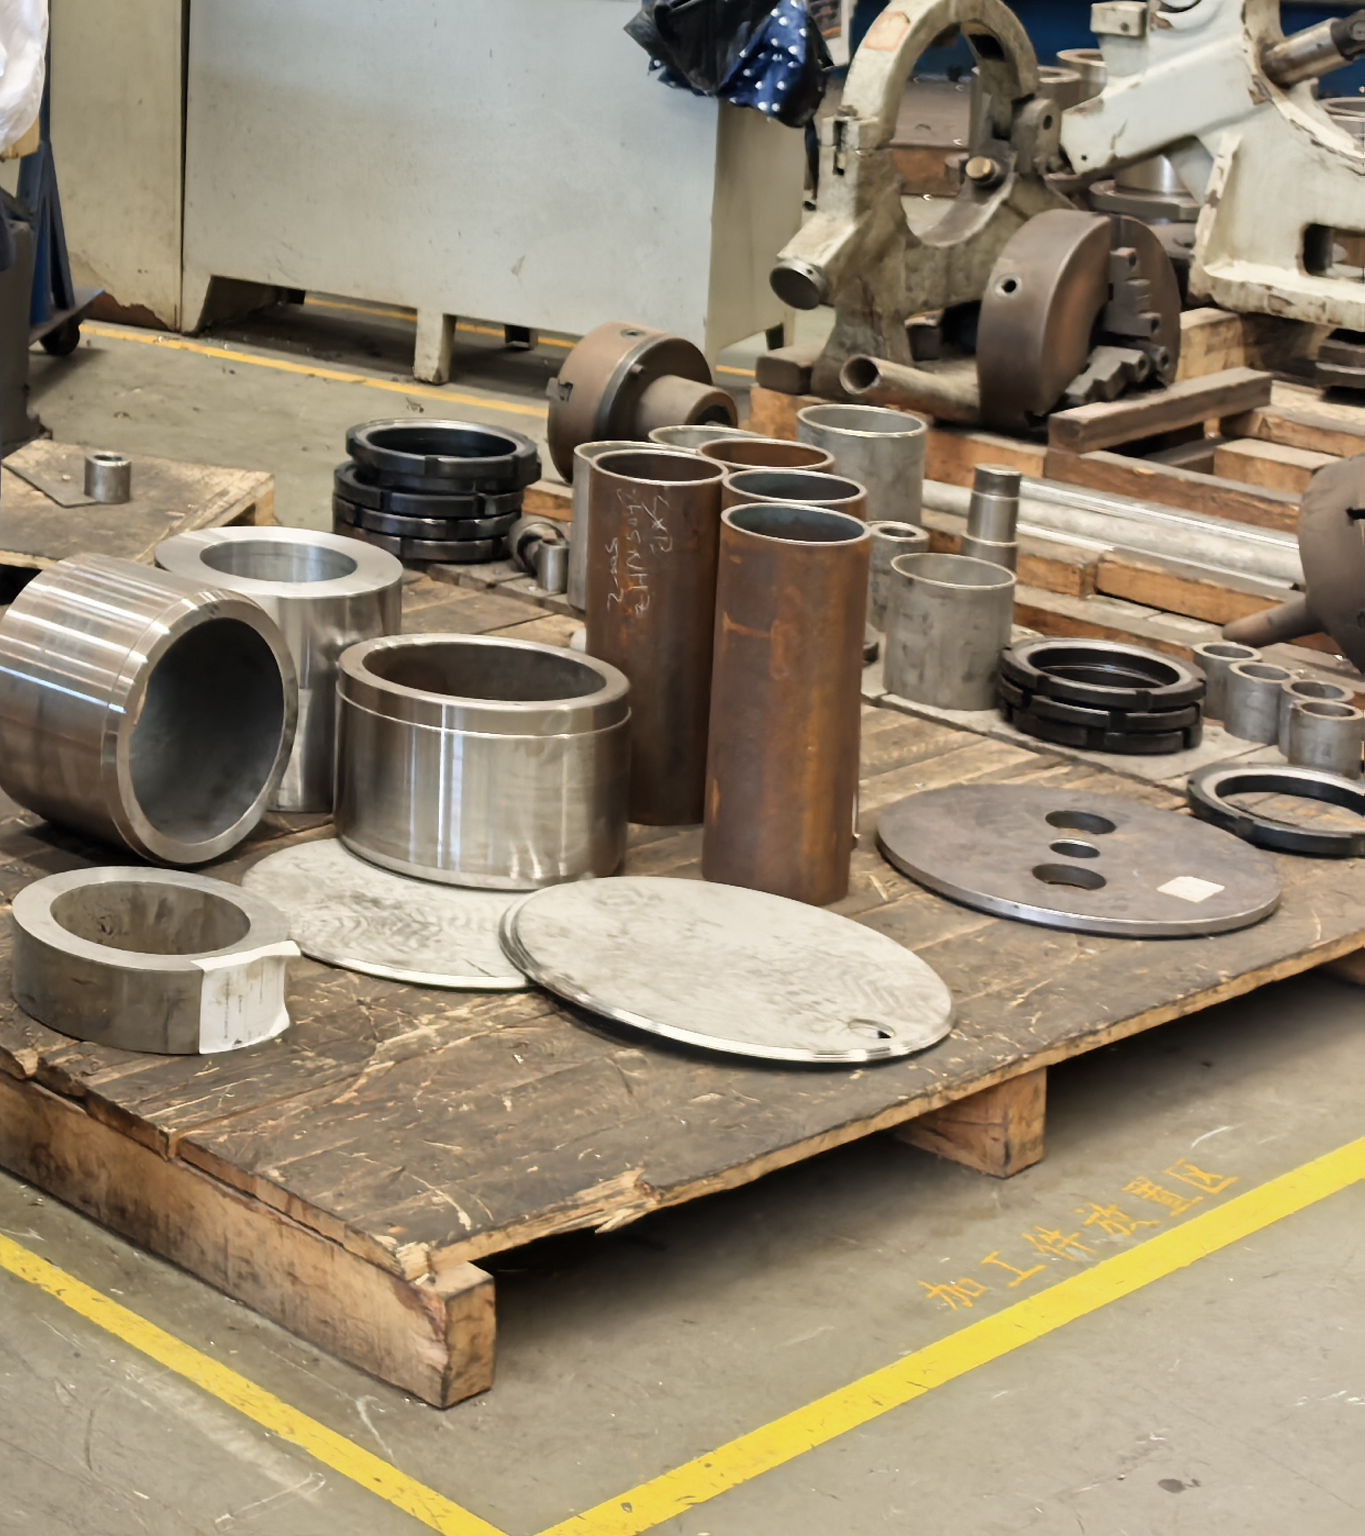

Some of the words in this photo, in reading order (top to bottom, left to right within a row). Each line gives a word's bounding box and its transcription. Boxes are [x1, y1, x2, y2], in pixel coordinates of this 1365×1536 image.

[918, 1158, 1239, 1312] 加工件放置区
